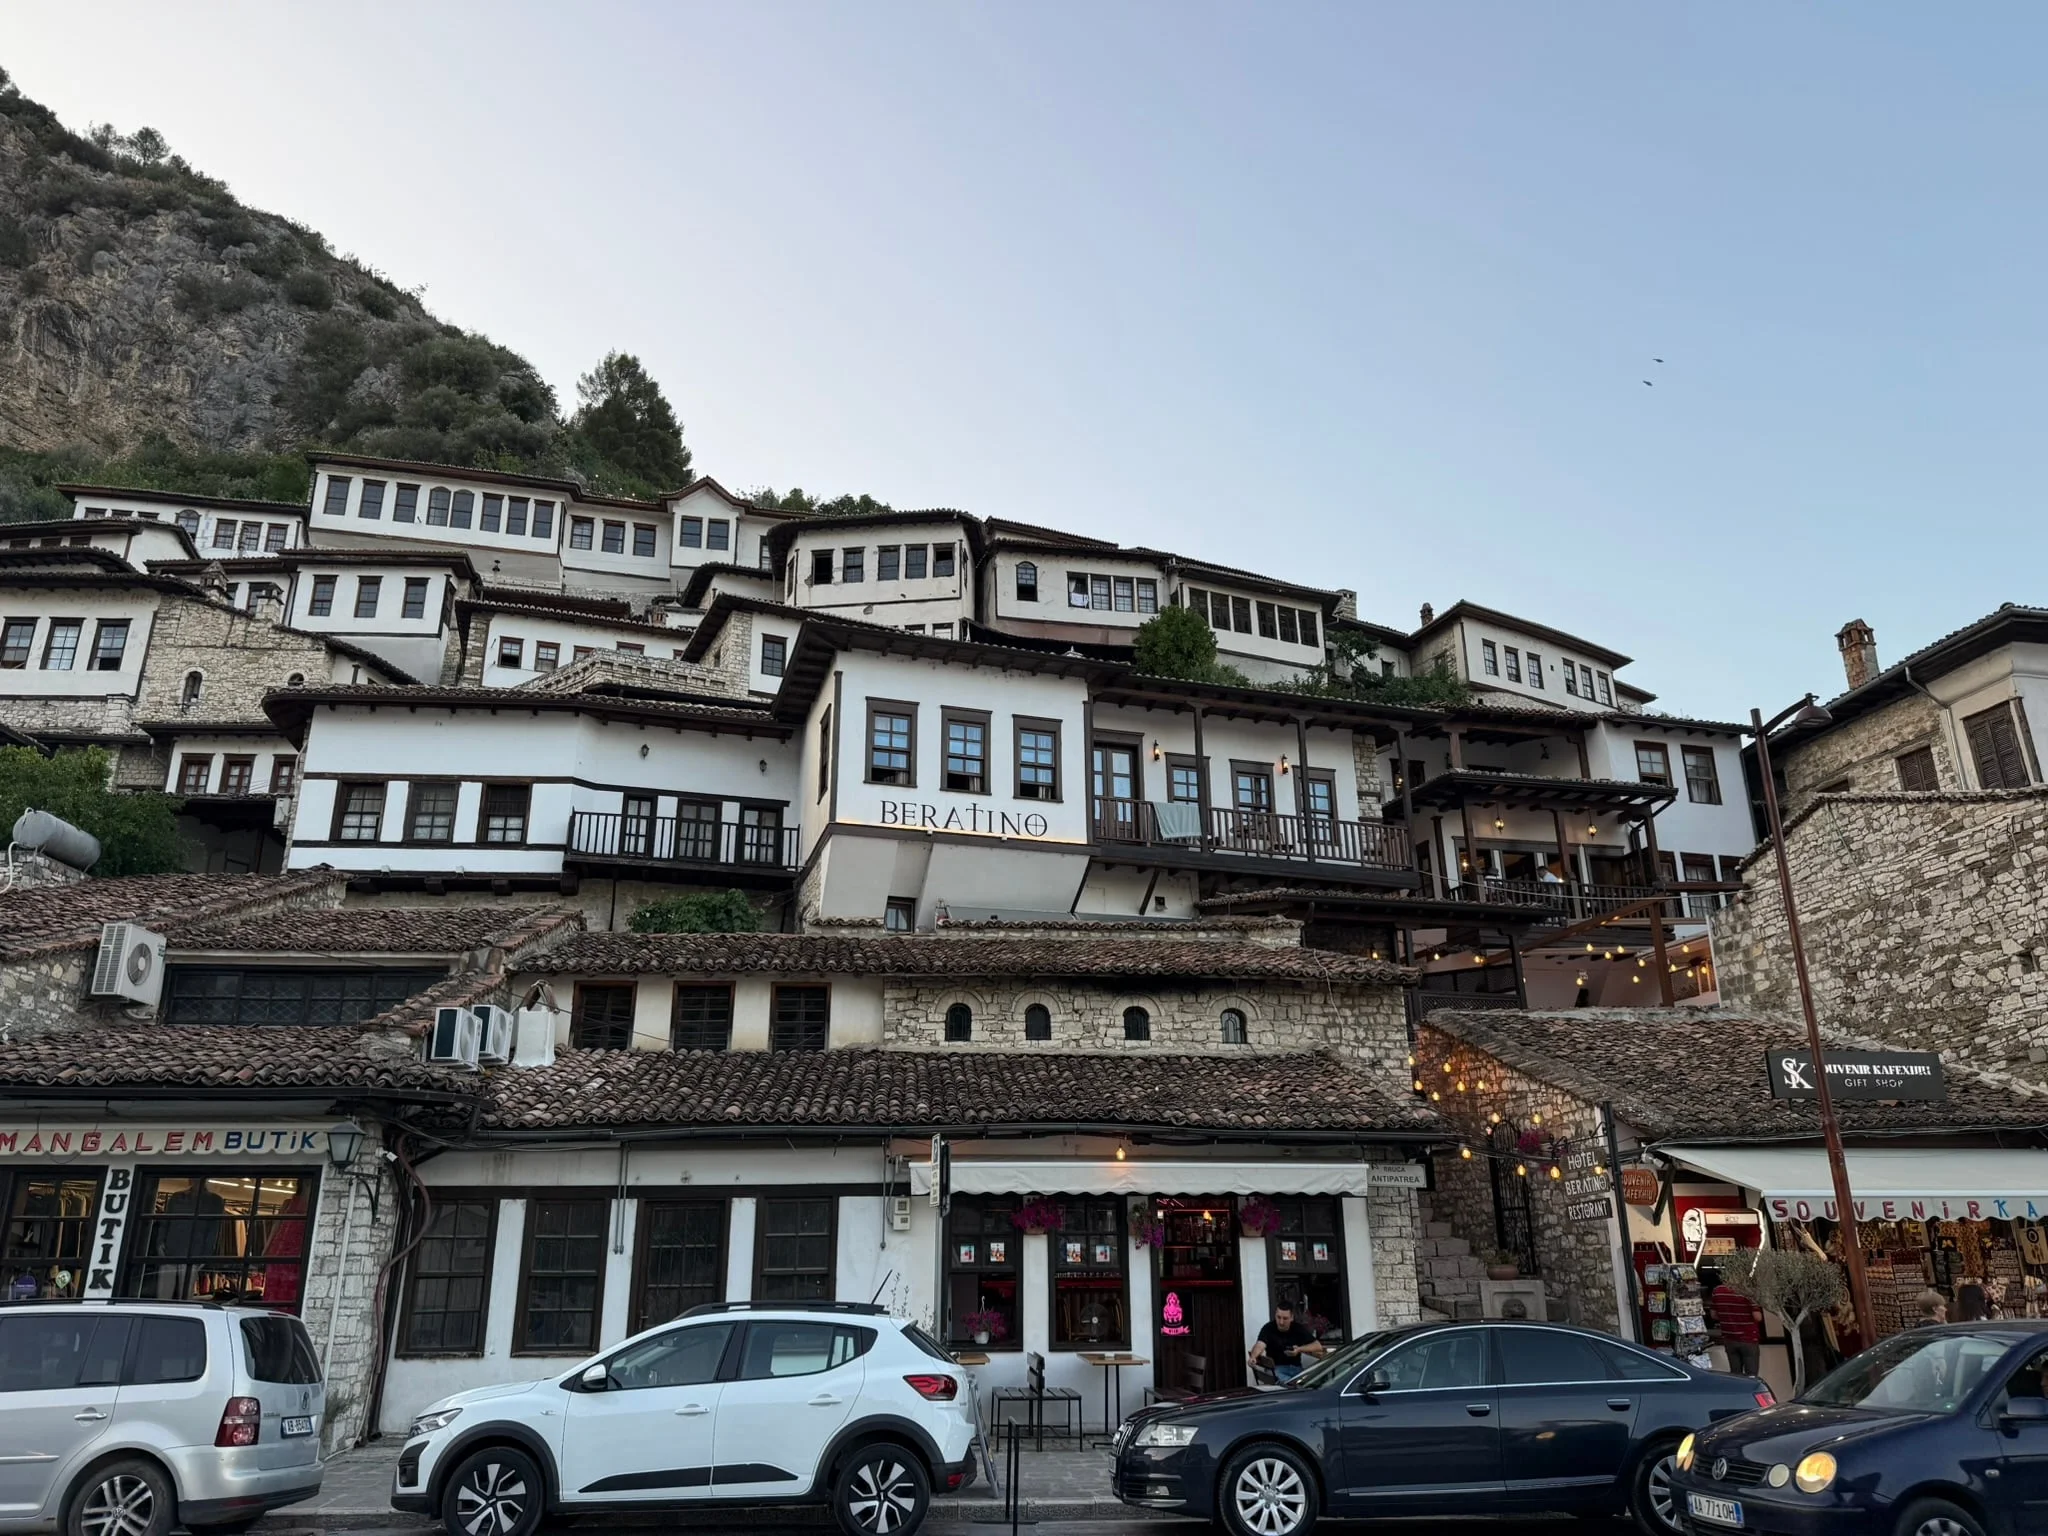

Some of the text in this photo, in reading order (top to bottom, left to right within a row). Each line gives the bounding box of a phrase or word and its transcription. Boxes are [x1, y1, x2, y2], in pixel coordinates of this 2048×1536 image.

[880, 800, 1048, 837] BERATINO
[1813, 1064, 1871, 1075] OUVENIR
[1844, 1078, 1904, 1088] GIFT SHOP
[0, 1131, 214, 1152] MANGALEM
[1568, 1152, 1598, 1169] HOTEL
[1565, 1175, 1607, 1195] BERATINO
[1623, 1174, 1652, 1186] OUVENIR
[1568, 1201, 1607, 1220] RESTORANT
[88, 1168, 131, 1290] BUTIK
